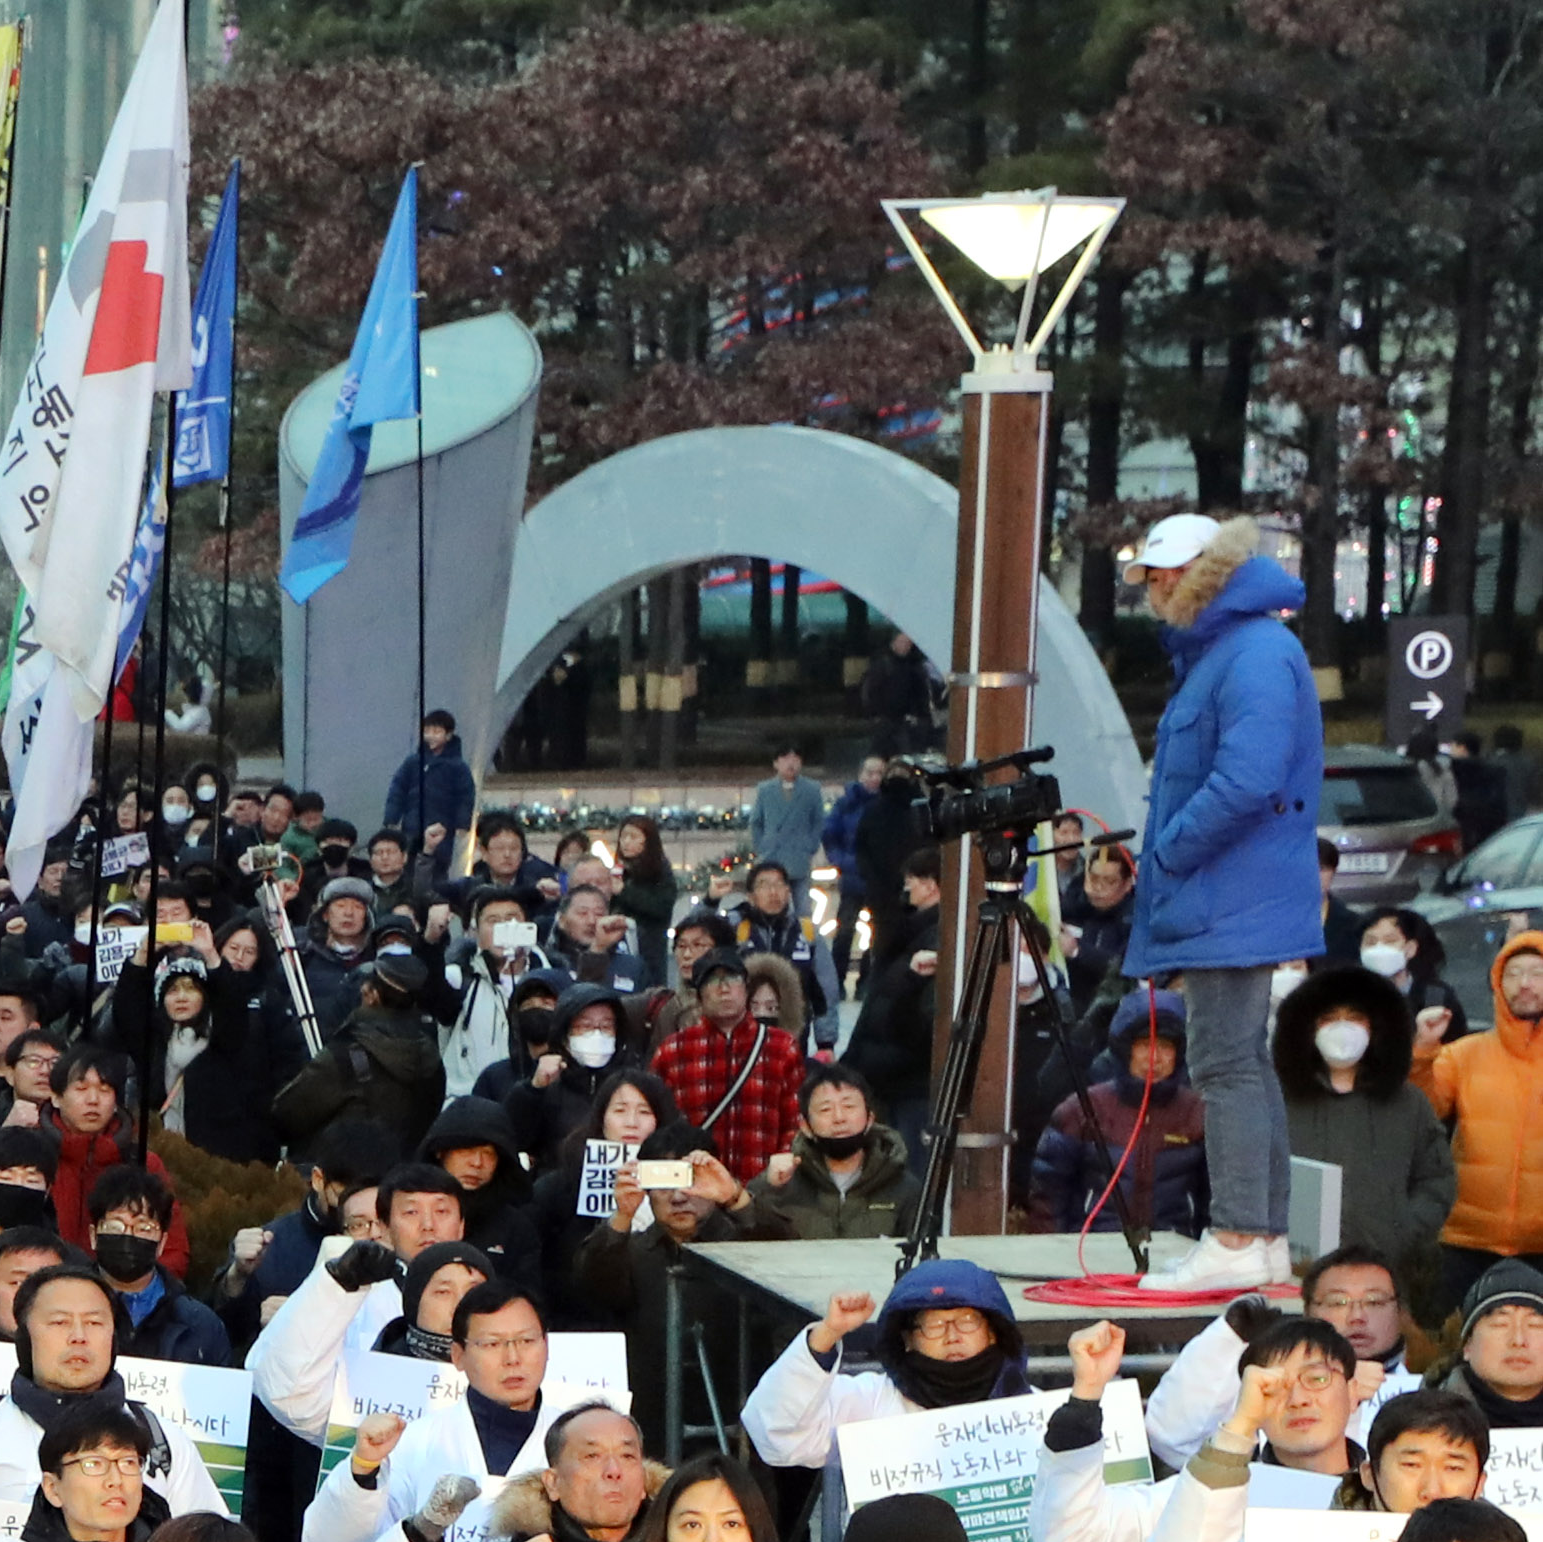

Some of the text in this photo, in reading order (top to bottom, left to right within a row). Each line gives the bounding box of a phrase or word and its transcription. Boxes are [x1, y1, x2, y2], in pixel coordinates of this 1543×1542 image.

[587, 1144, 631, 1165] 내가
[870, 1460, 944, 1492] 비정규직
[950, 1446, 1031, 1481] 노동자와
